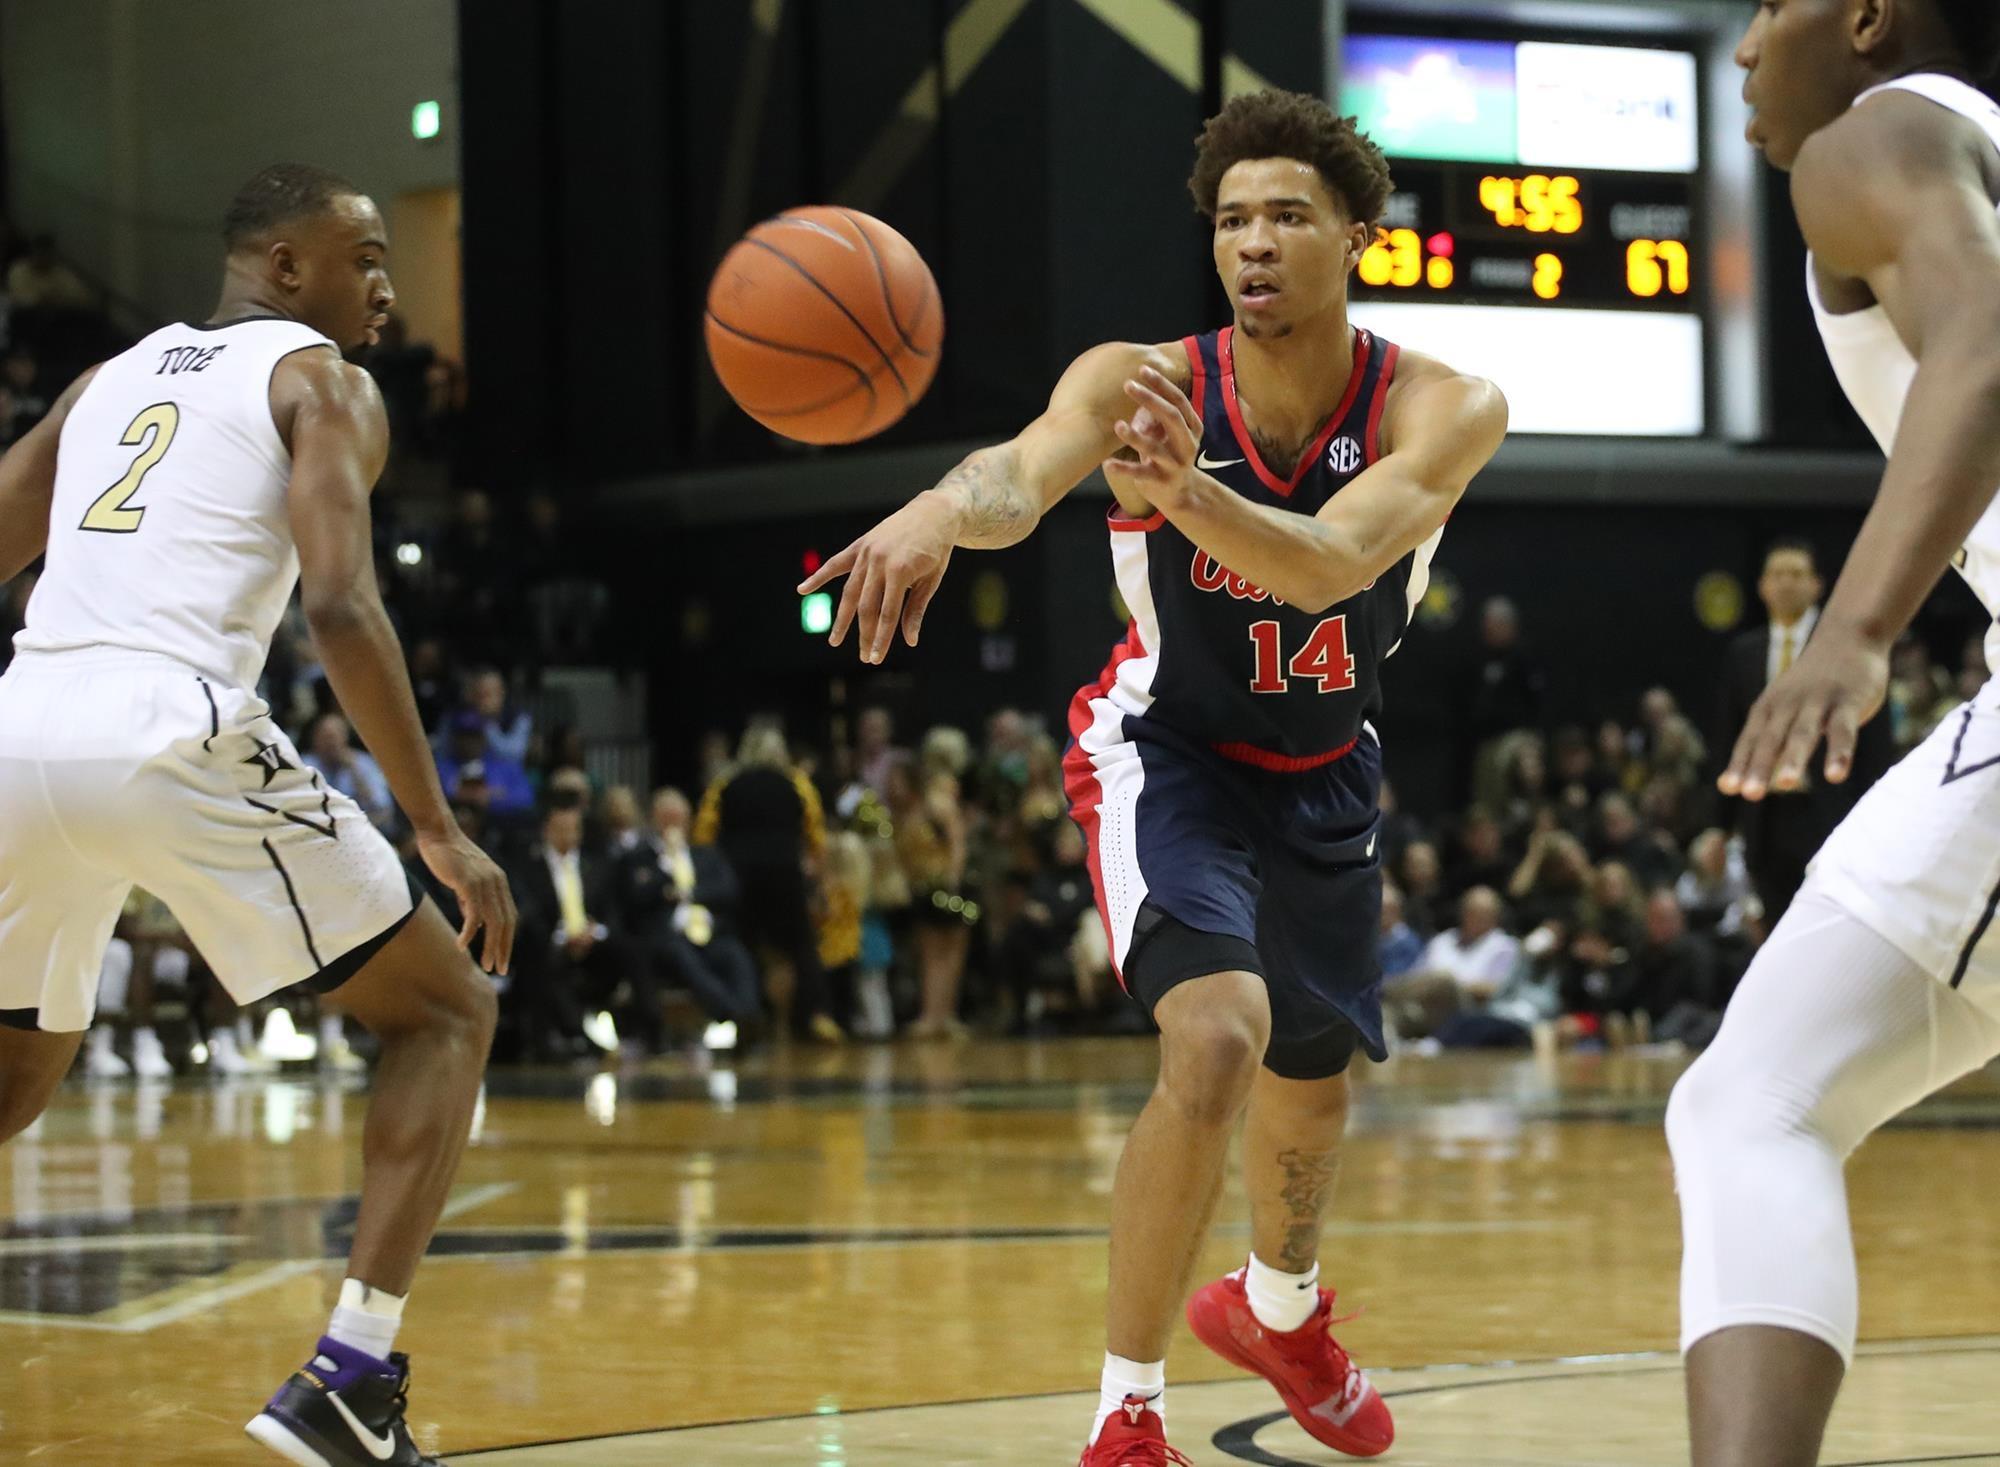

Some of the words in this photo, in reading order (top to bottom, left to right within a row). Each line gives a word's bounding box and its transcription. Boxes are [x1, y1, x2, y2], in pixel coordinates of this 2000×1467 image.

[1626, 239, 1689, 297] 67
[78, 401, 180, 533] 2
[1328, 436, 1361, 473] SEC
[1249, 614, 1355, 694] 14
